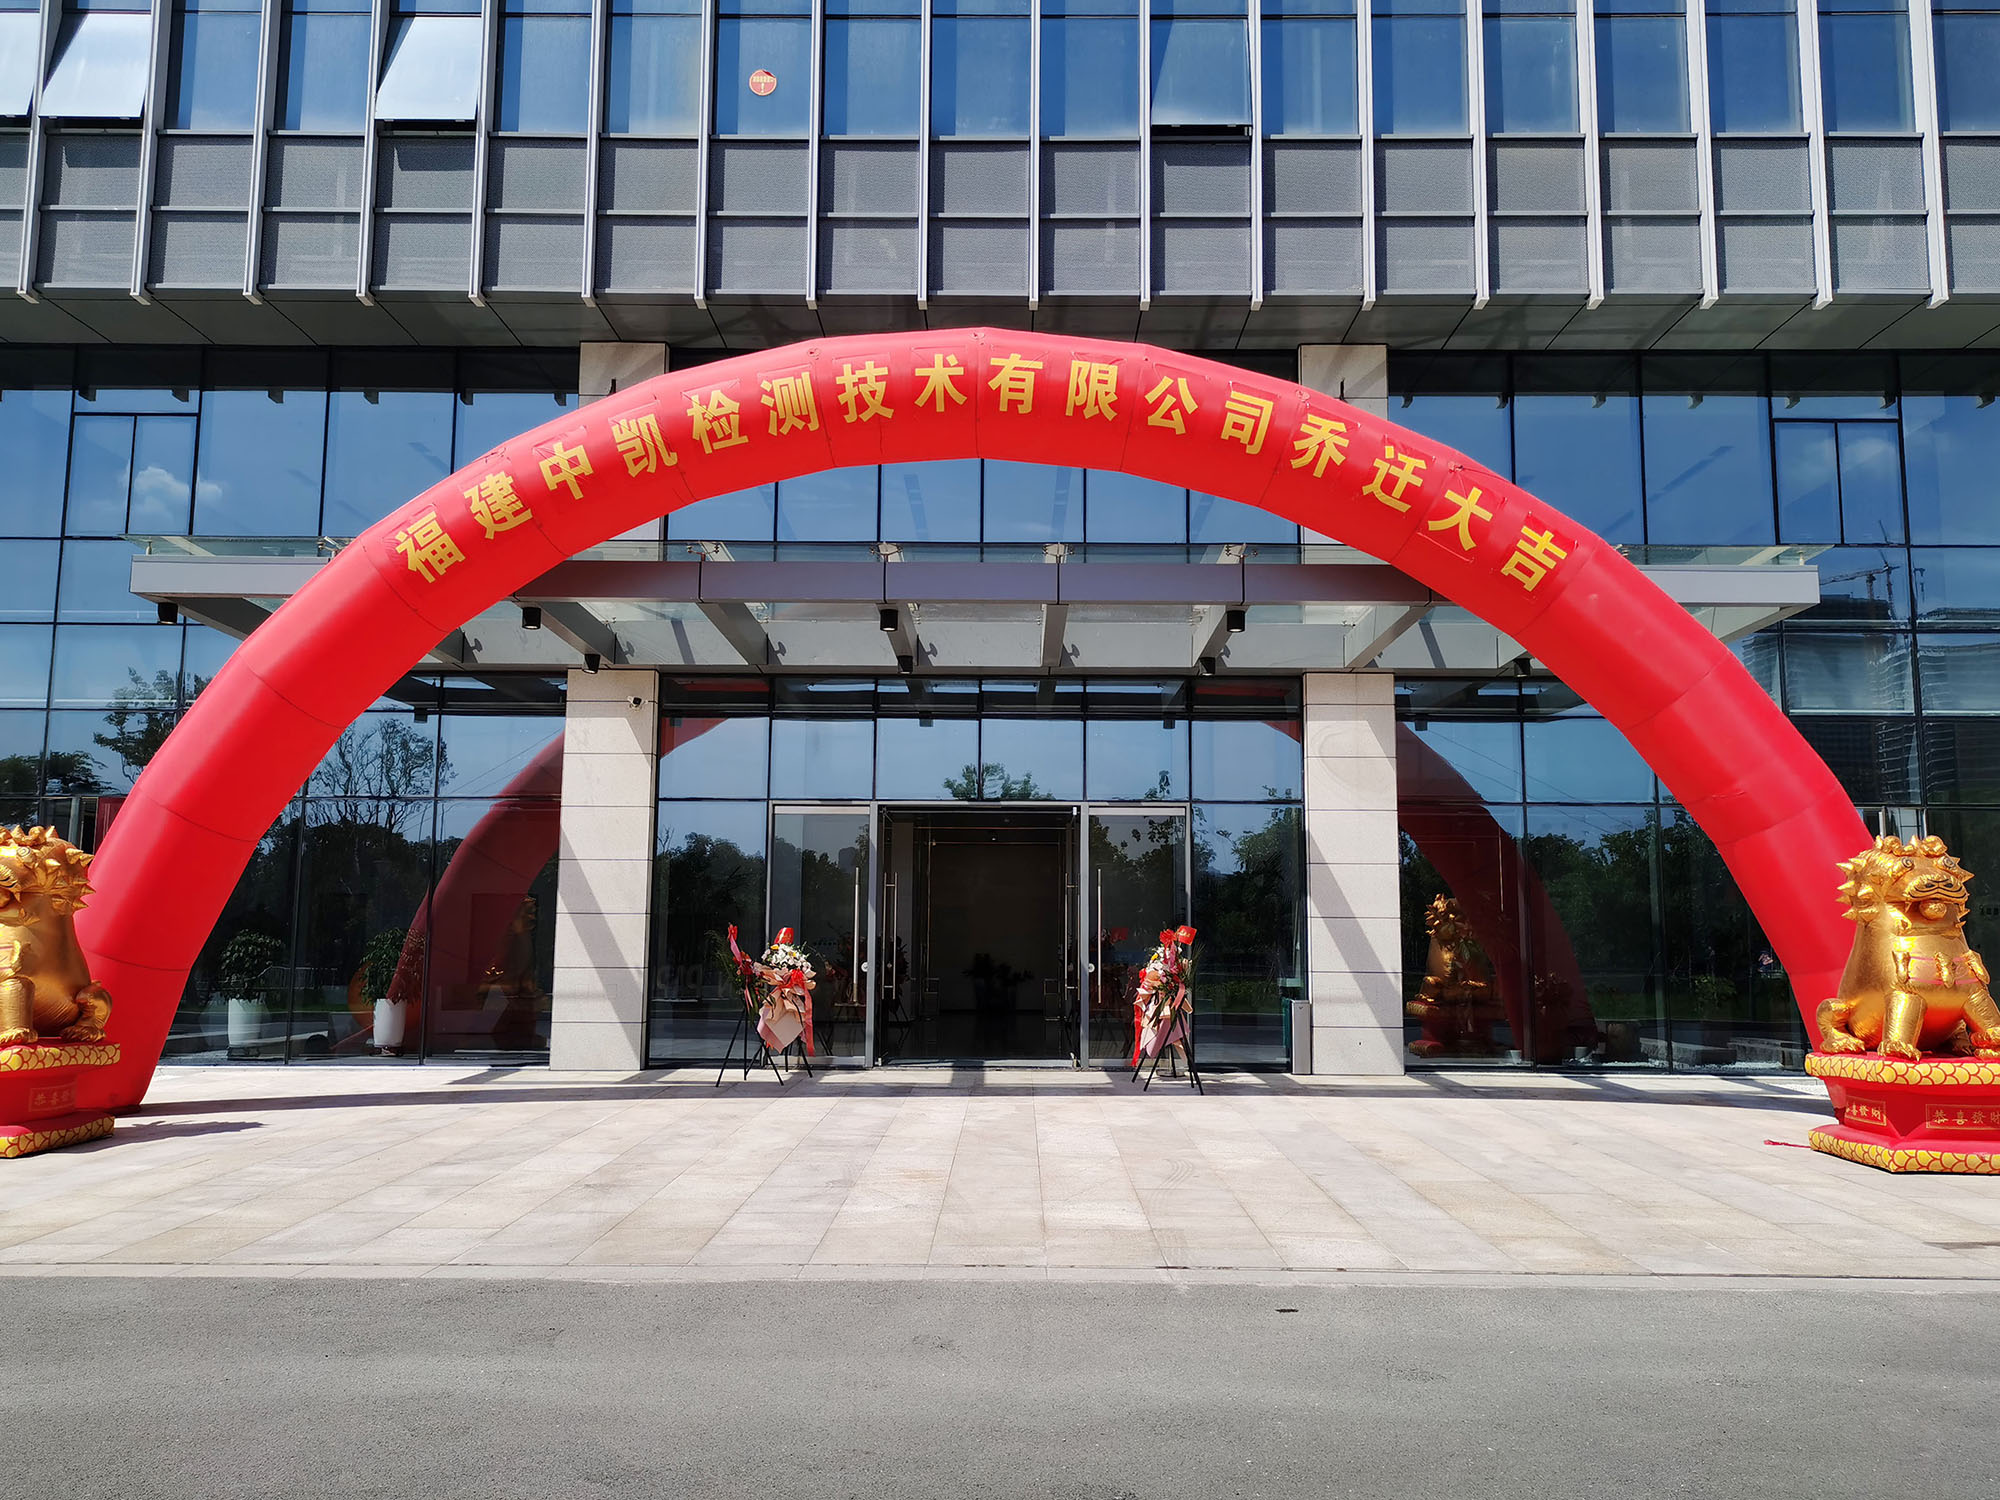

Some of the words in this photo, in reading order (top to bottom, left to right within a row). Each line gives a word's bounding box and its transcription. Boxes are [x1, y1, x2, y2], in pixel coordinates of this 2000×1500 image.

[396, 354, 1567, 591] 福建中凯检测技术有限公司乔迁大吉
